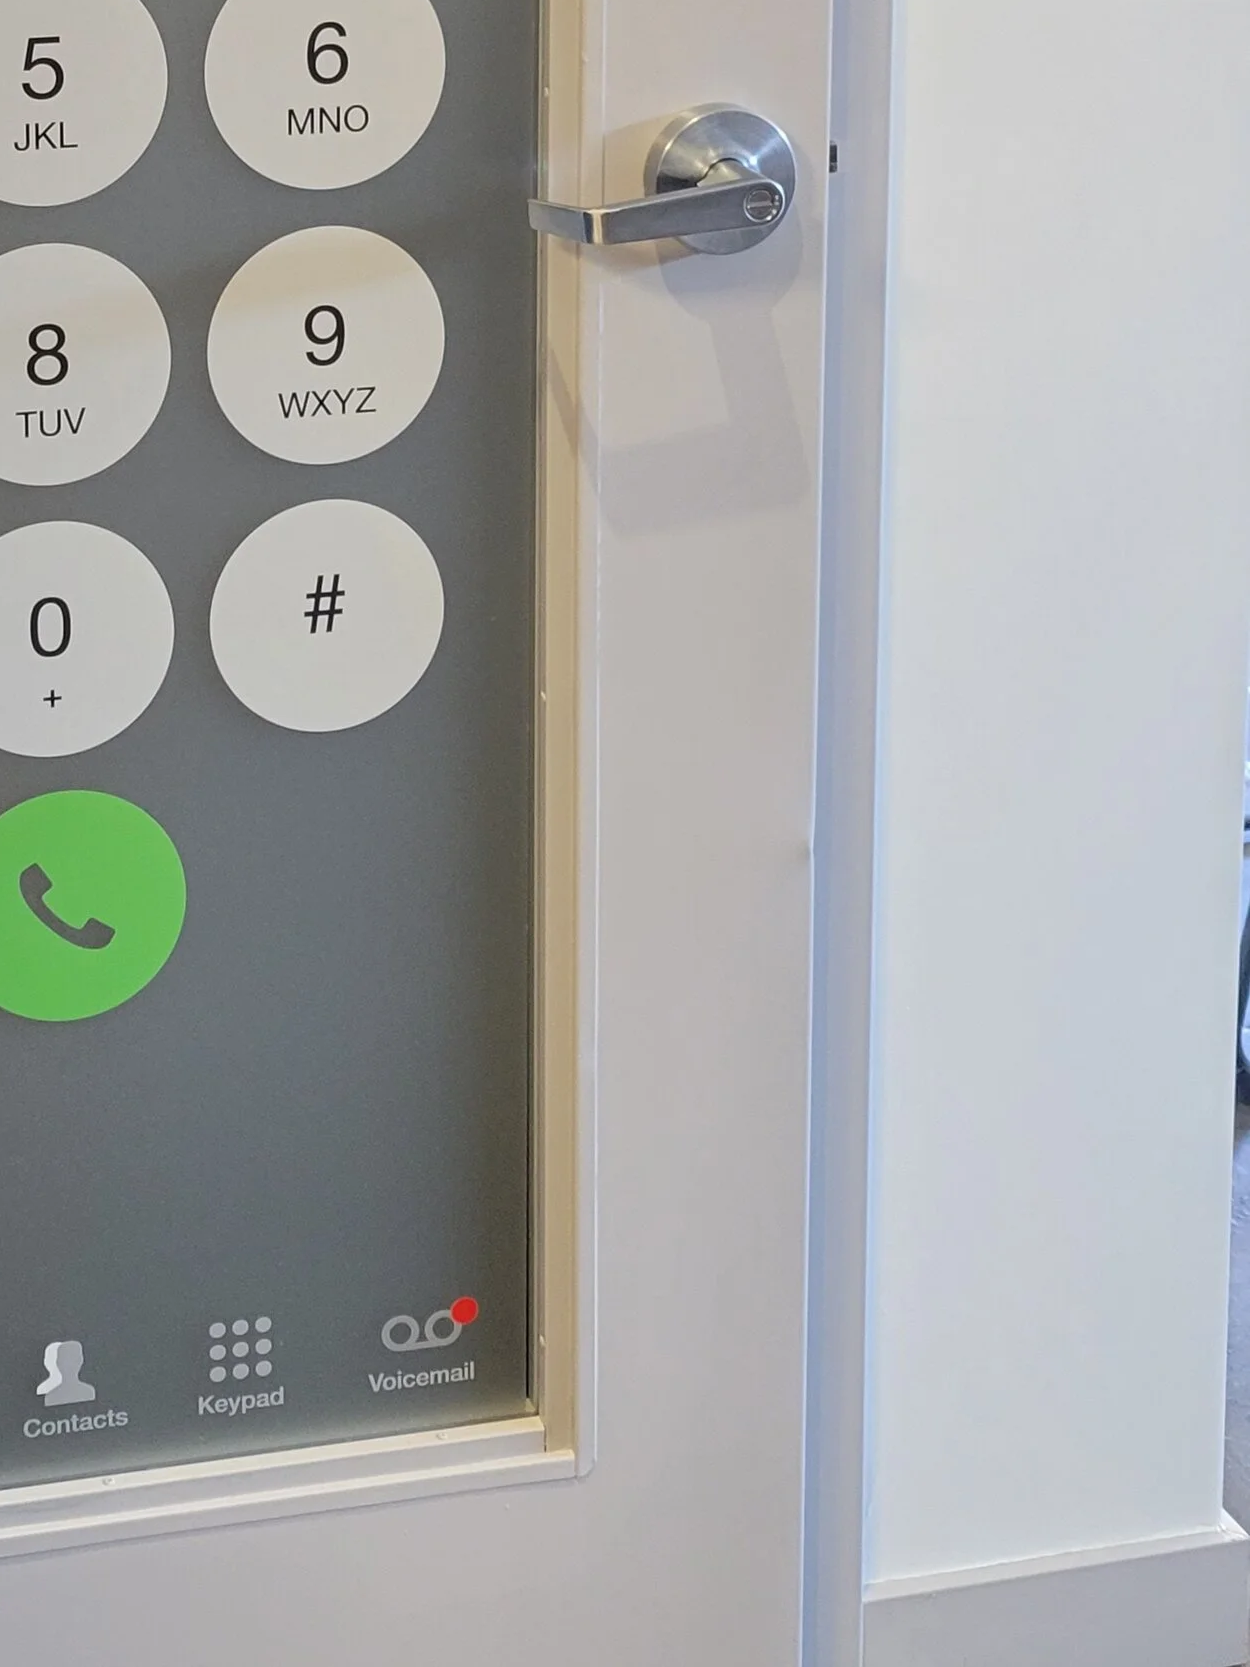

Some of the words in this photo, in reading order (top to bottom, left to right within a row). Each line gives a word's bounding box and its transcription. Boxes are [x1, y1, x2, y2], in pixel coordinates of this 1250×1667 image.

[21, 36, 65, 100] 5
[306, 21, 349, 85] 6
[13, 121, 78, 152] JKL
[287, 104, 369, 136] MNO
[304, 304, 346, 367] 9
[26, 323, 69, 386] 8
[278, 386, 377, 419] WXYZ
[15, 407, 86, 438] TUV
[303, 573, 346, 634] #
[29, 596, 72, 658] 0
[368, 1361, 475, 1393] Voicemail
[198, 1385, 285, 1417] Keypad
[23, 1408, 129, 1438] Contacts
